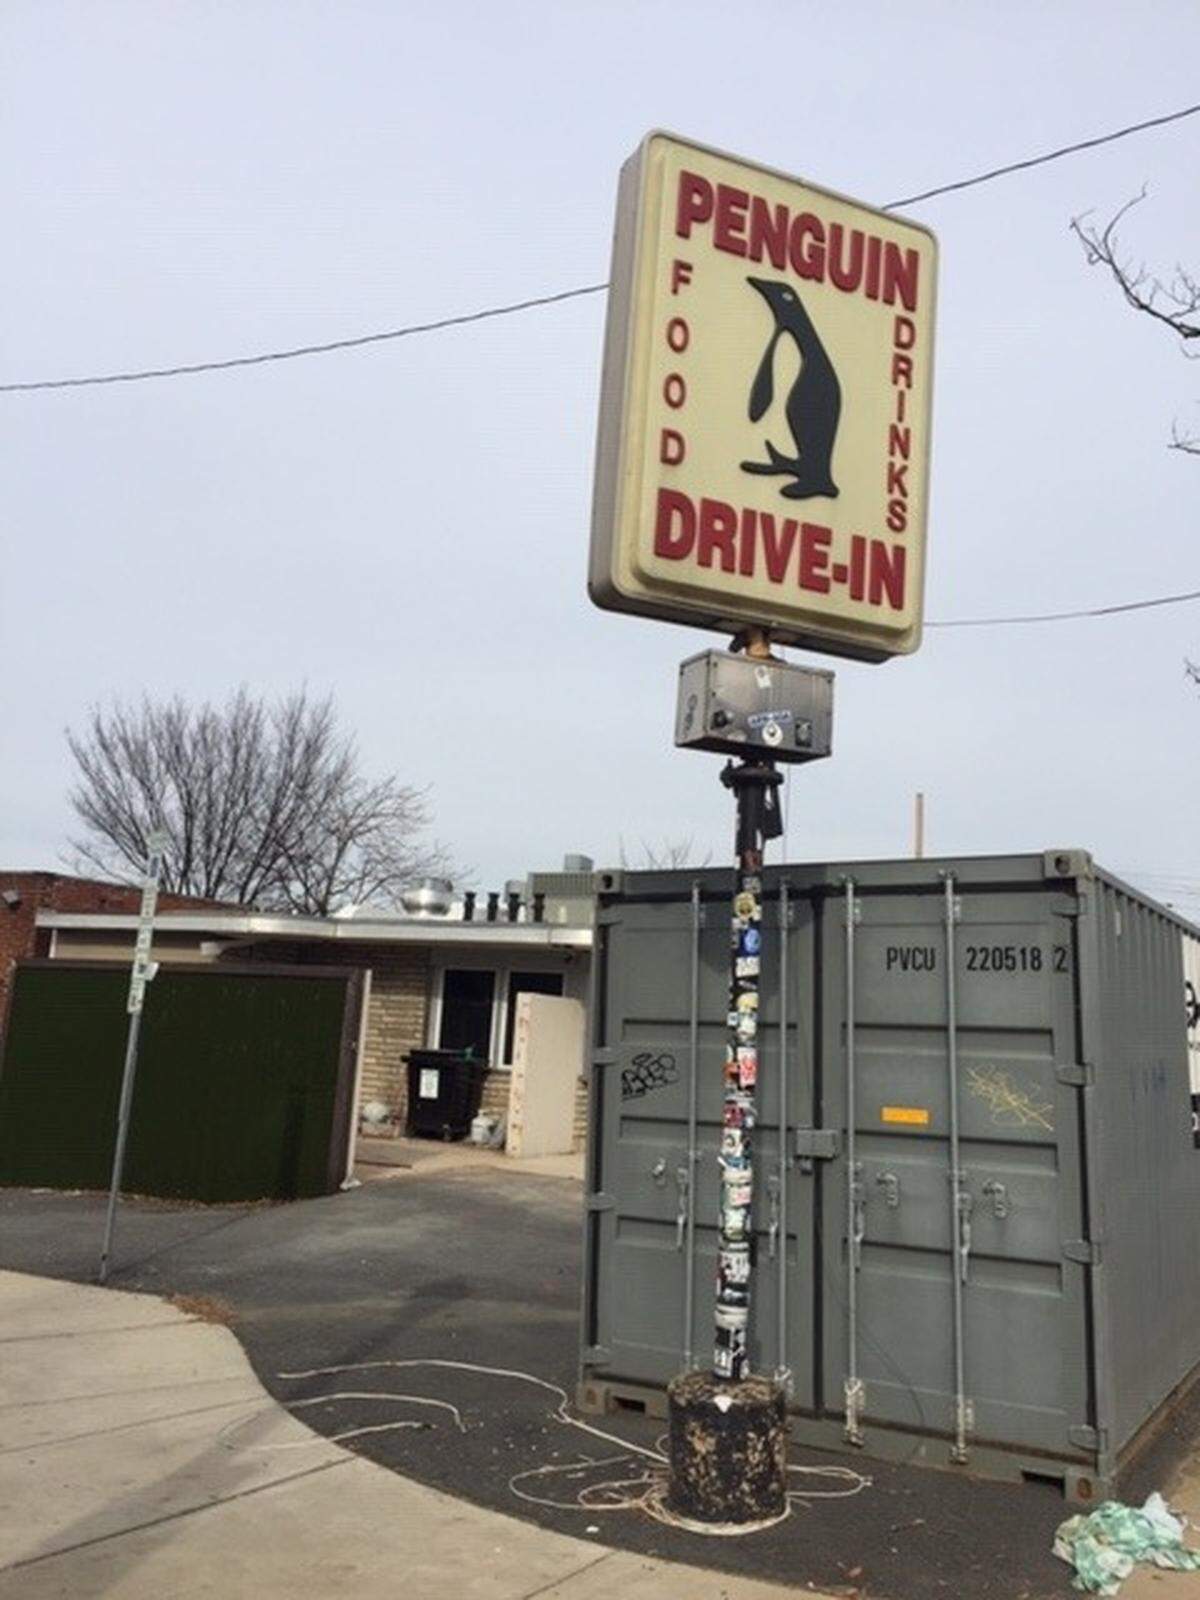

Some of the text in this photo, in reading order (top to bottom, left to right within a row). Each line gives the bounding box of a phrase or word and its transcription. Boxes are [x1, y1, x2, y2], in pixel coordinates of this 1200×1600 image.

[674, 168, 919, 313] PENGUIN
[660, 259, 693, 467] FOOD
[885, 315, 917, 534] DRINKS
[653, 487, 907, 611] DRIVE-IN
[886, 945, 1069, 973] PVCU 220518 2
